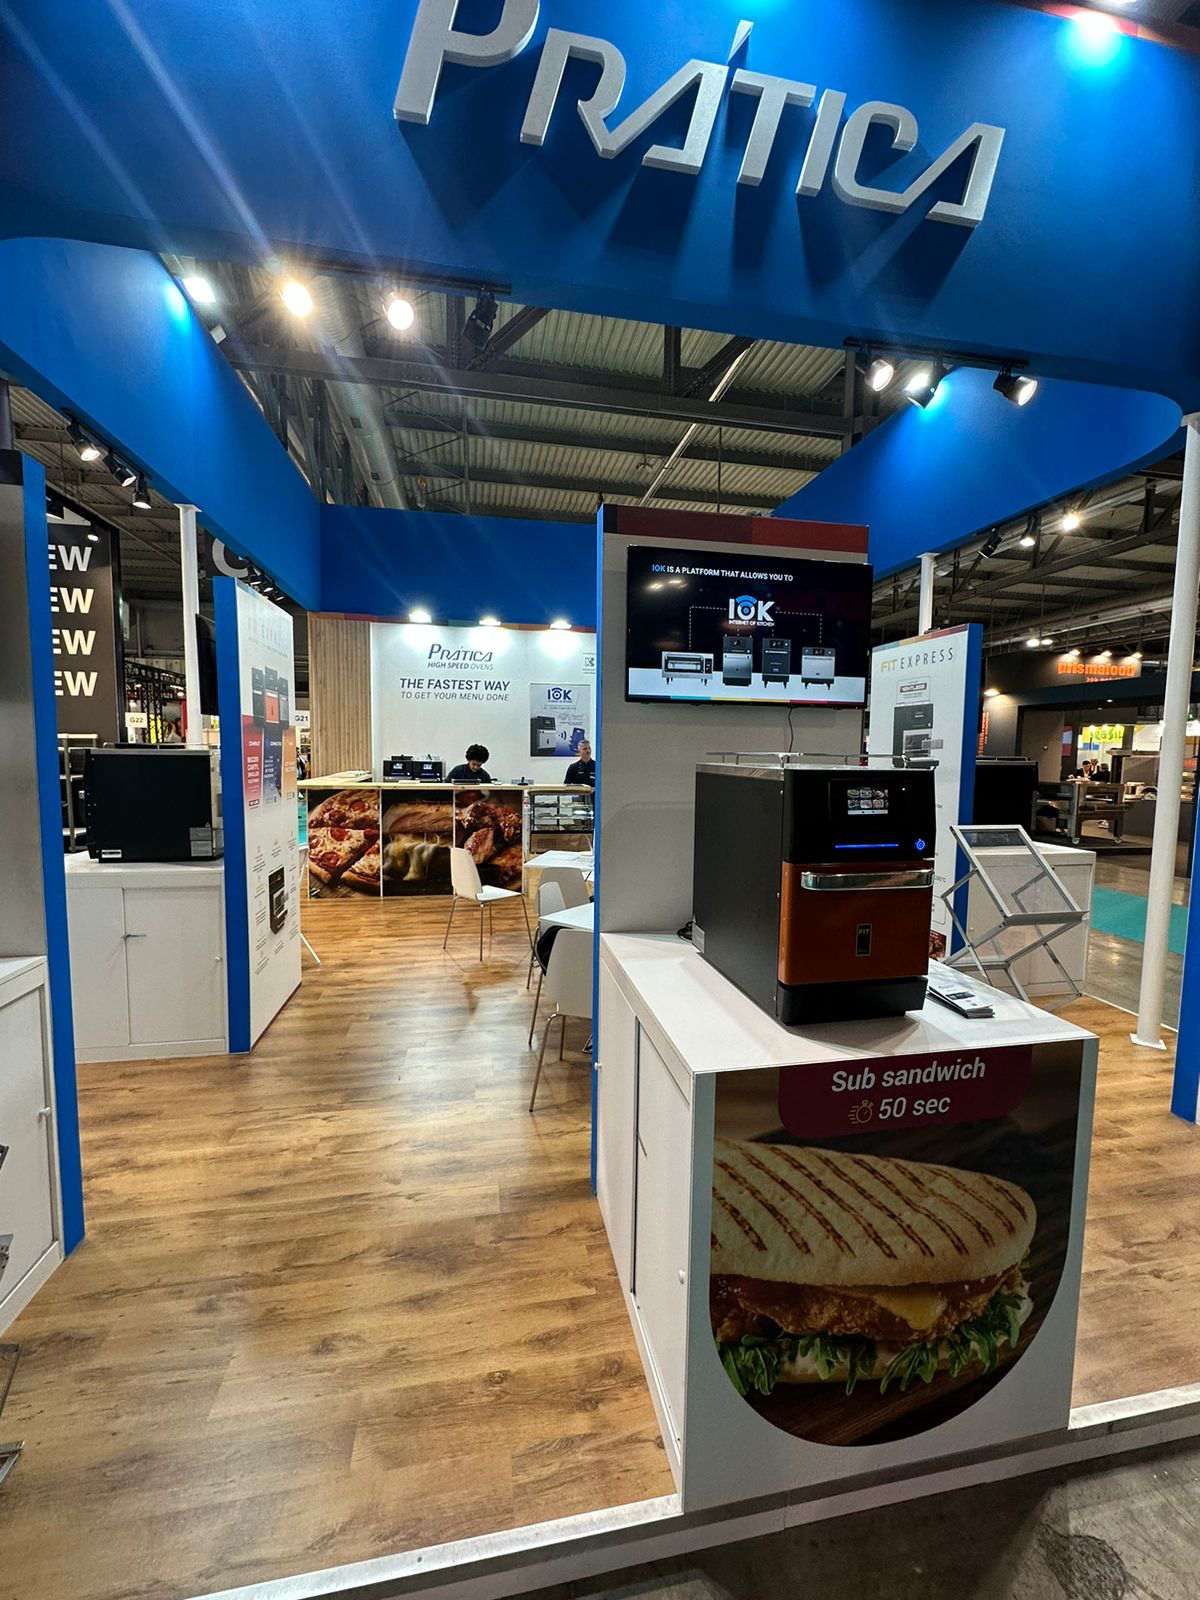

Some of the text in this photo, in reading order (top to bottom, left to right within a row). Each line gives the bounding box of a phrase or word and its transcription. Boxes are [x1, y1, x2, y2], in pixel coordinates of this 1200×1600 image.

[667, 565, 675, 573] IS
[675, 566, 681, 574] A
[681, 566, 720, 577] PLATFORM
[721, 569, 740, 578] THAT
[740, 571, 769, 580] ALLOWS
[769, 573, 784, 582] YOU
[784, 574, 794, 582] TO
[427, 661, 447, 669] HIGH
[447, 662, 470, 670] SPEED
[881, 648, 954, 672] FIT EXPRESS
[400, 678, 511, 691] THE FASTEST WAY
[401, 691, 510, 702] TO GET YOUR MENU DONE
[831, 1056, 986, 1093] Sub sandwich
[878, 1097, 951, 1120] 50 sec
